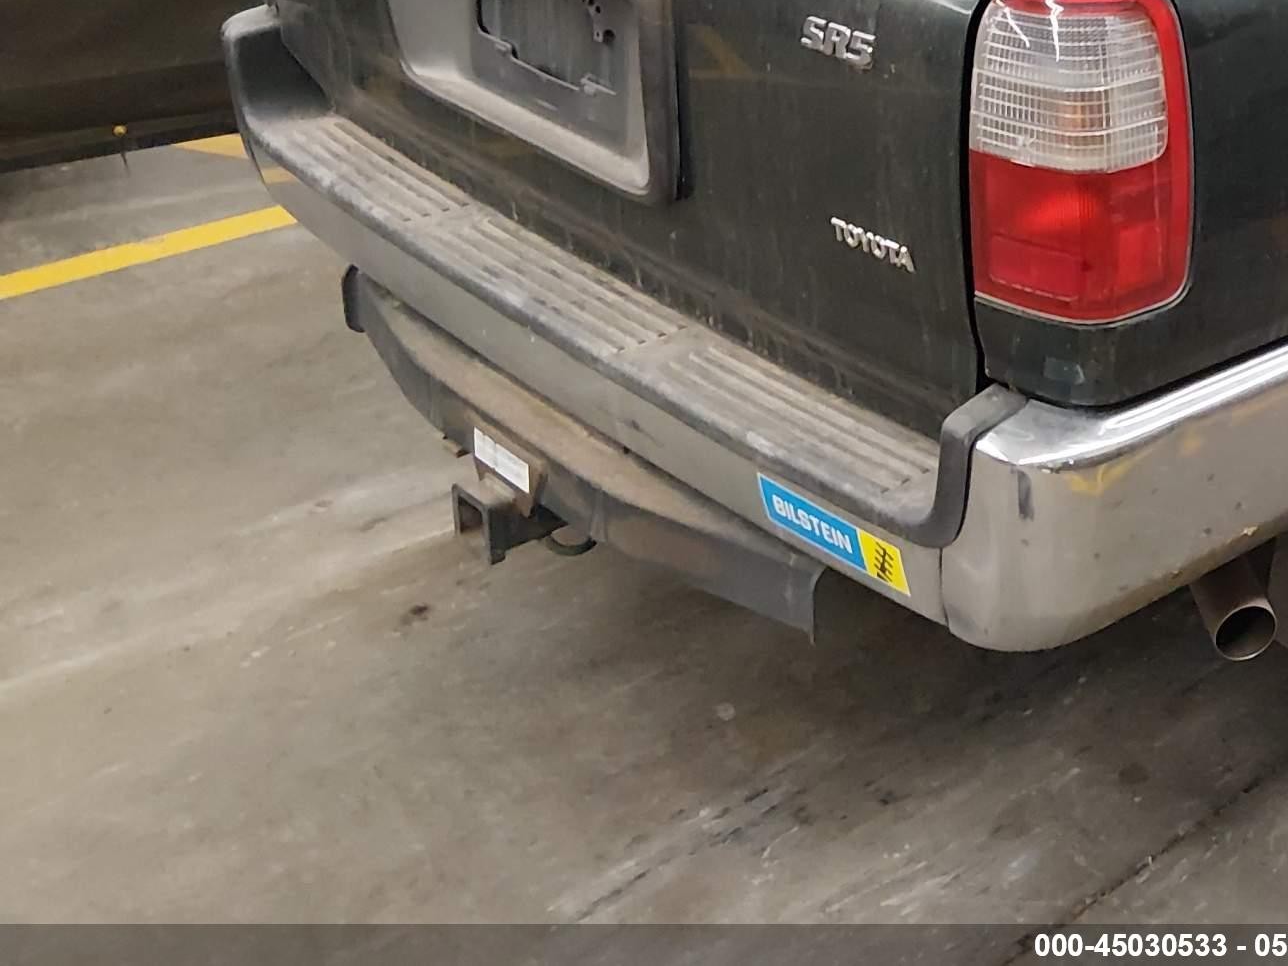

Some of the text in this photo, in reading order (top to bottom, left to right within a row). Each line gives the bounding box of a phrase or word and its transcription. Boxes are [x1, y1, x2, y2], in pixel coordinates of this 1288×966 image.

[801, 16, 876, 68] SR5
[830, 217, 915, 273] TOYOTA
[772, 494, 854, 554] BILSTEIN
